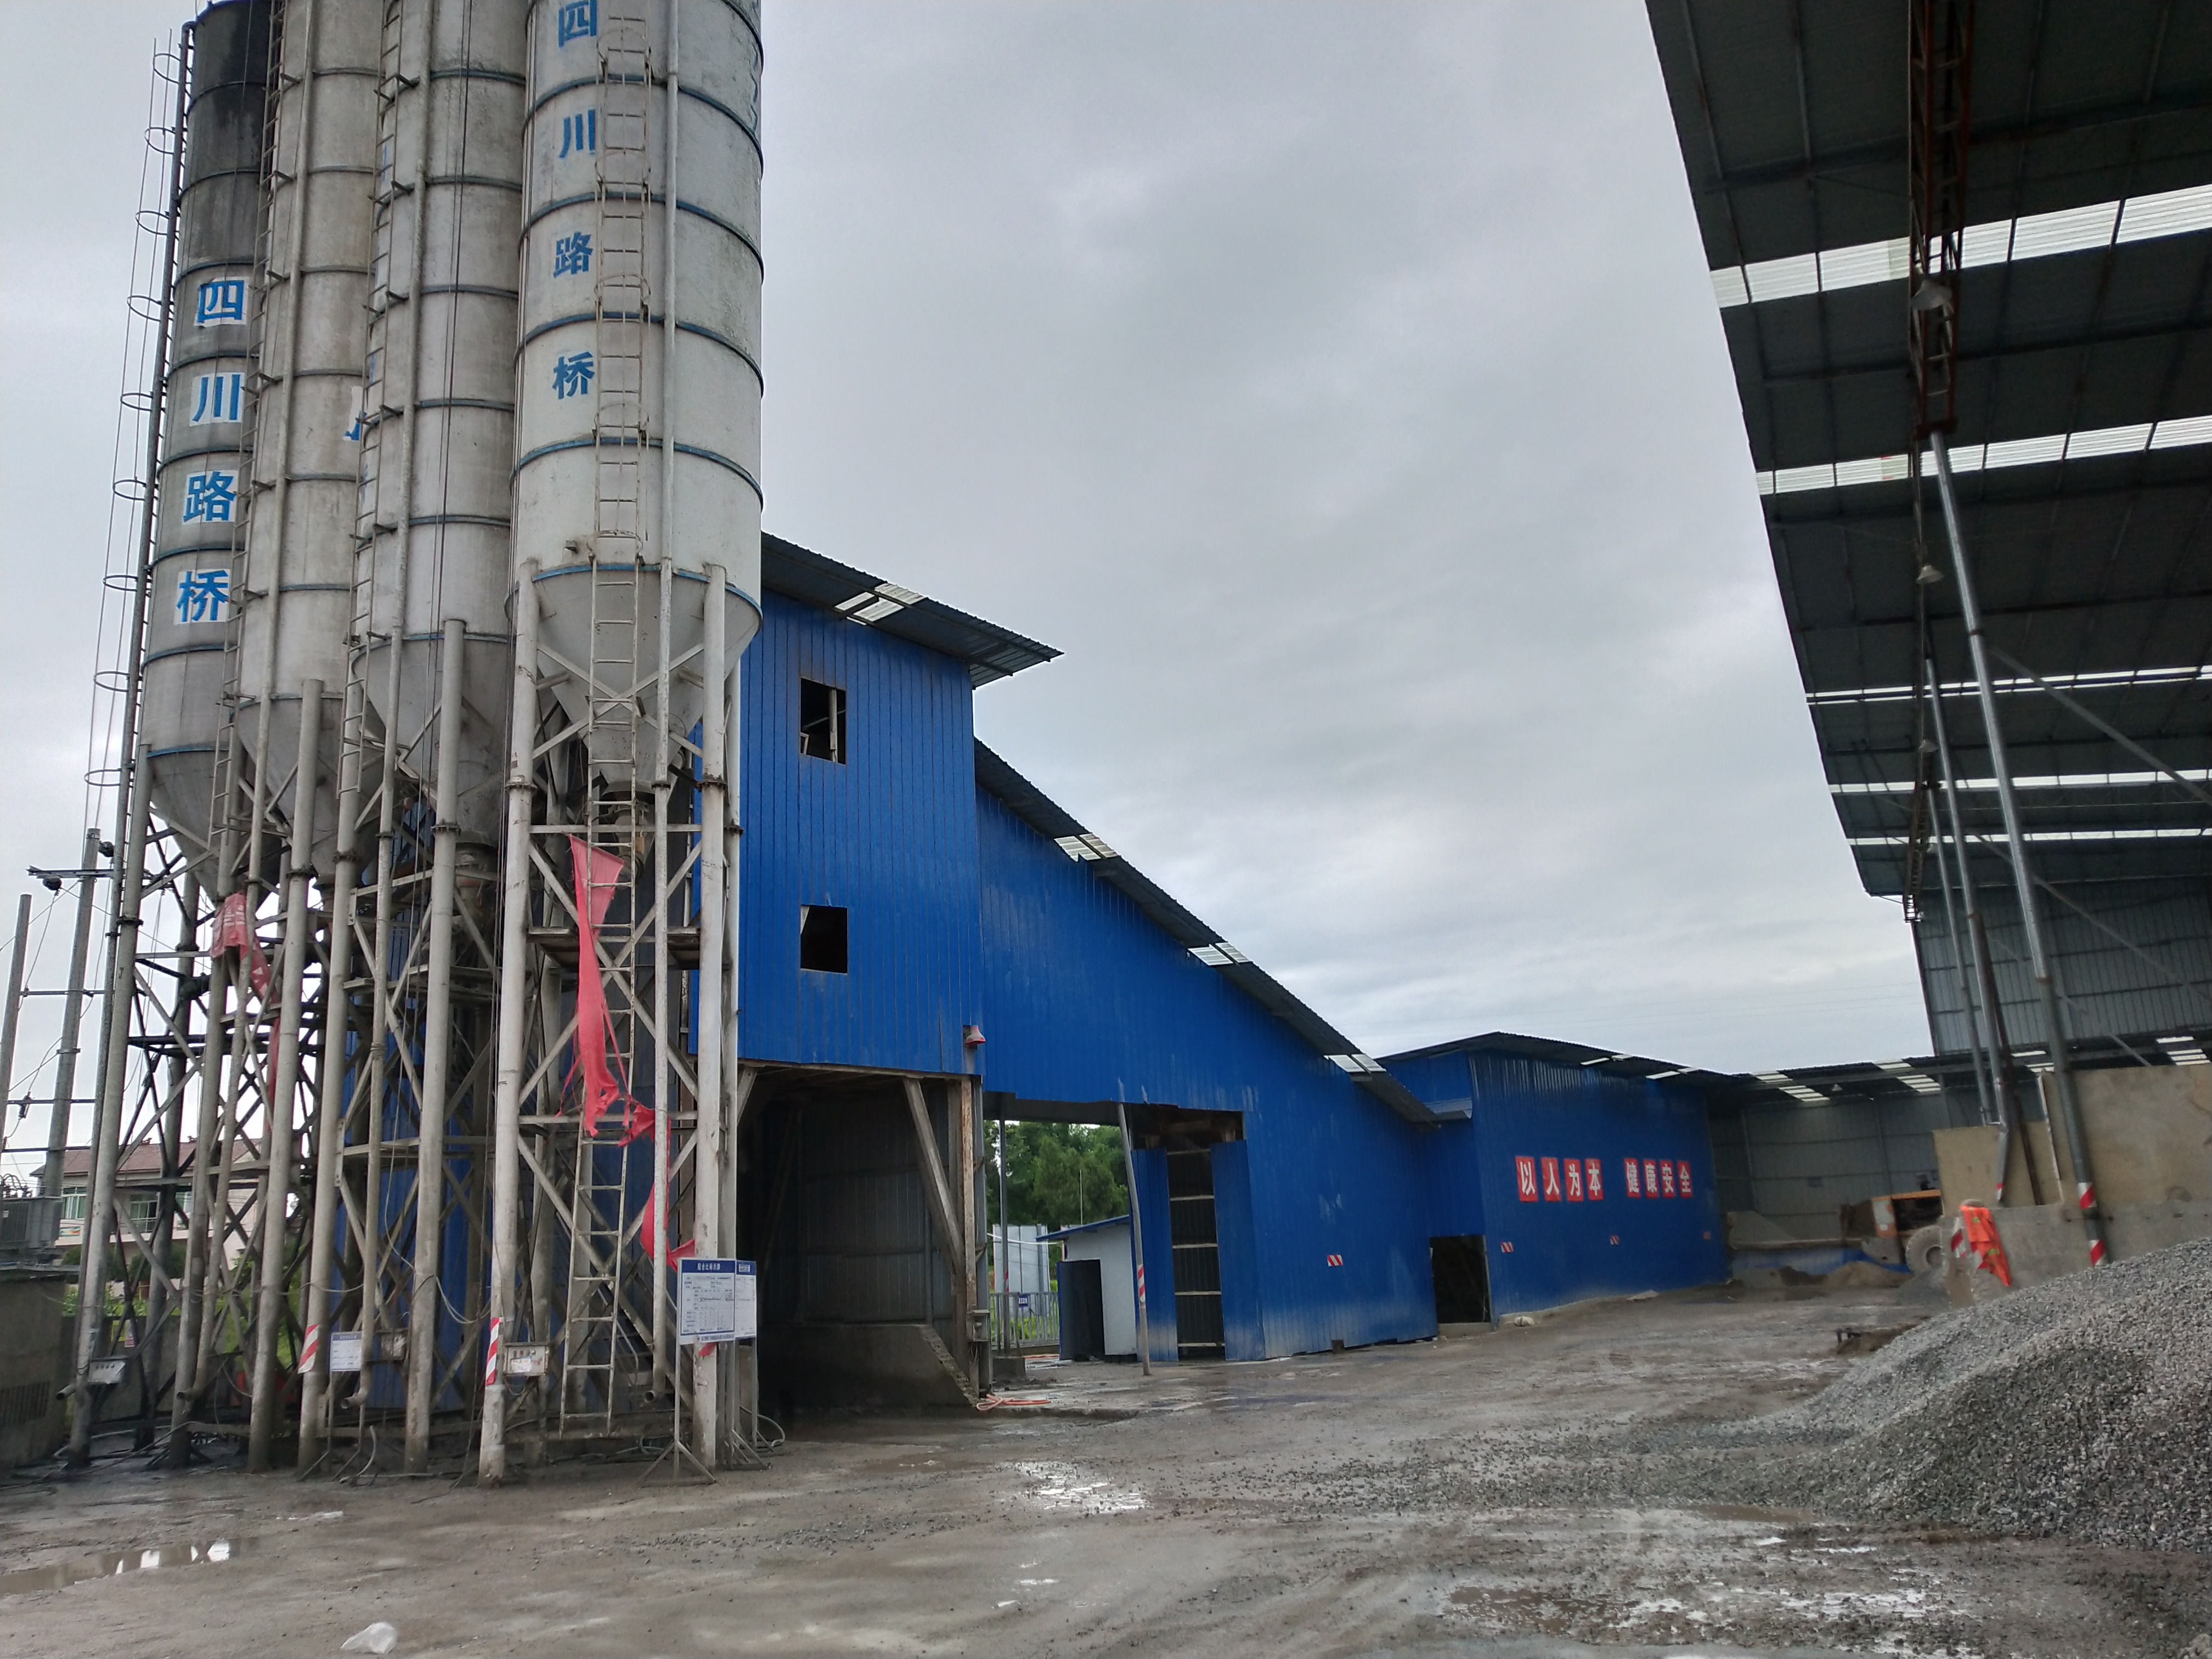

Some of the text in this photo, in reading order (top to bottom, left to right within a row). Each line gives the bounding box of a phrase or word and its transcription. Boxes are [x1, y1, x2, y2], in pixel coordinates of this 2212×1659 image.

[552, 0, 597, 400] 四川路桥
[176, 279, 245, 623] 四川路桥
[1519, 1161, 1601, 1197] 以人为本
[1626, 1161, 1691, 1194] 健康安全
